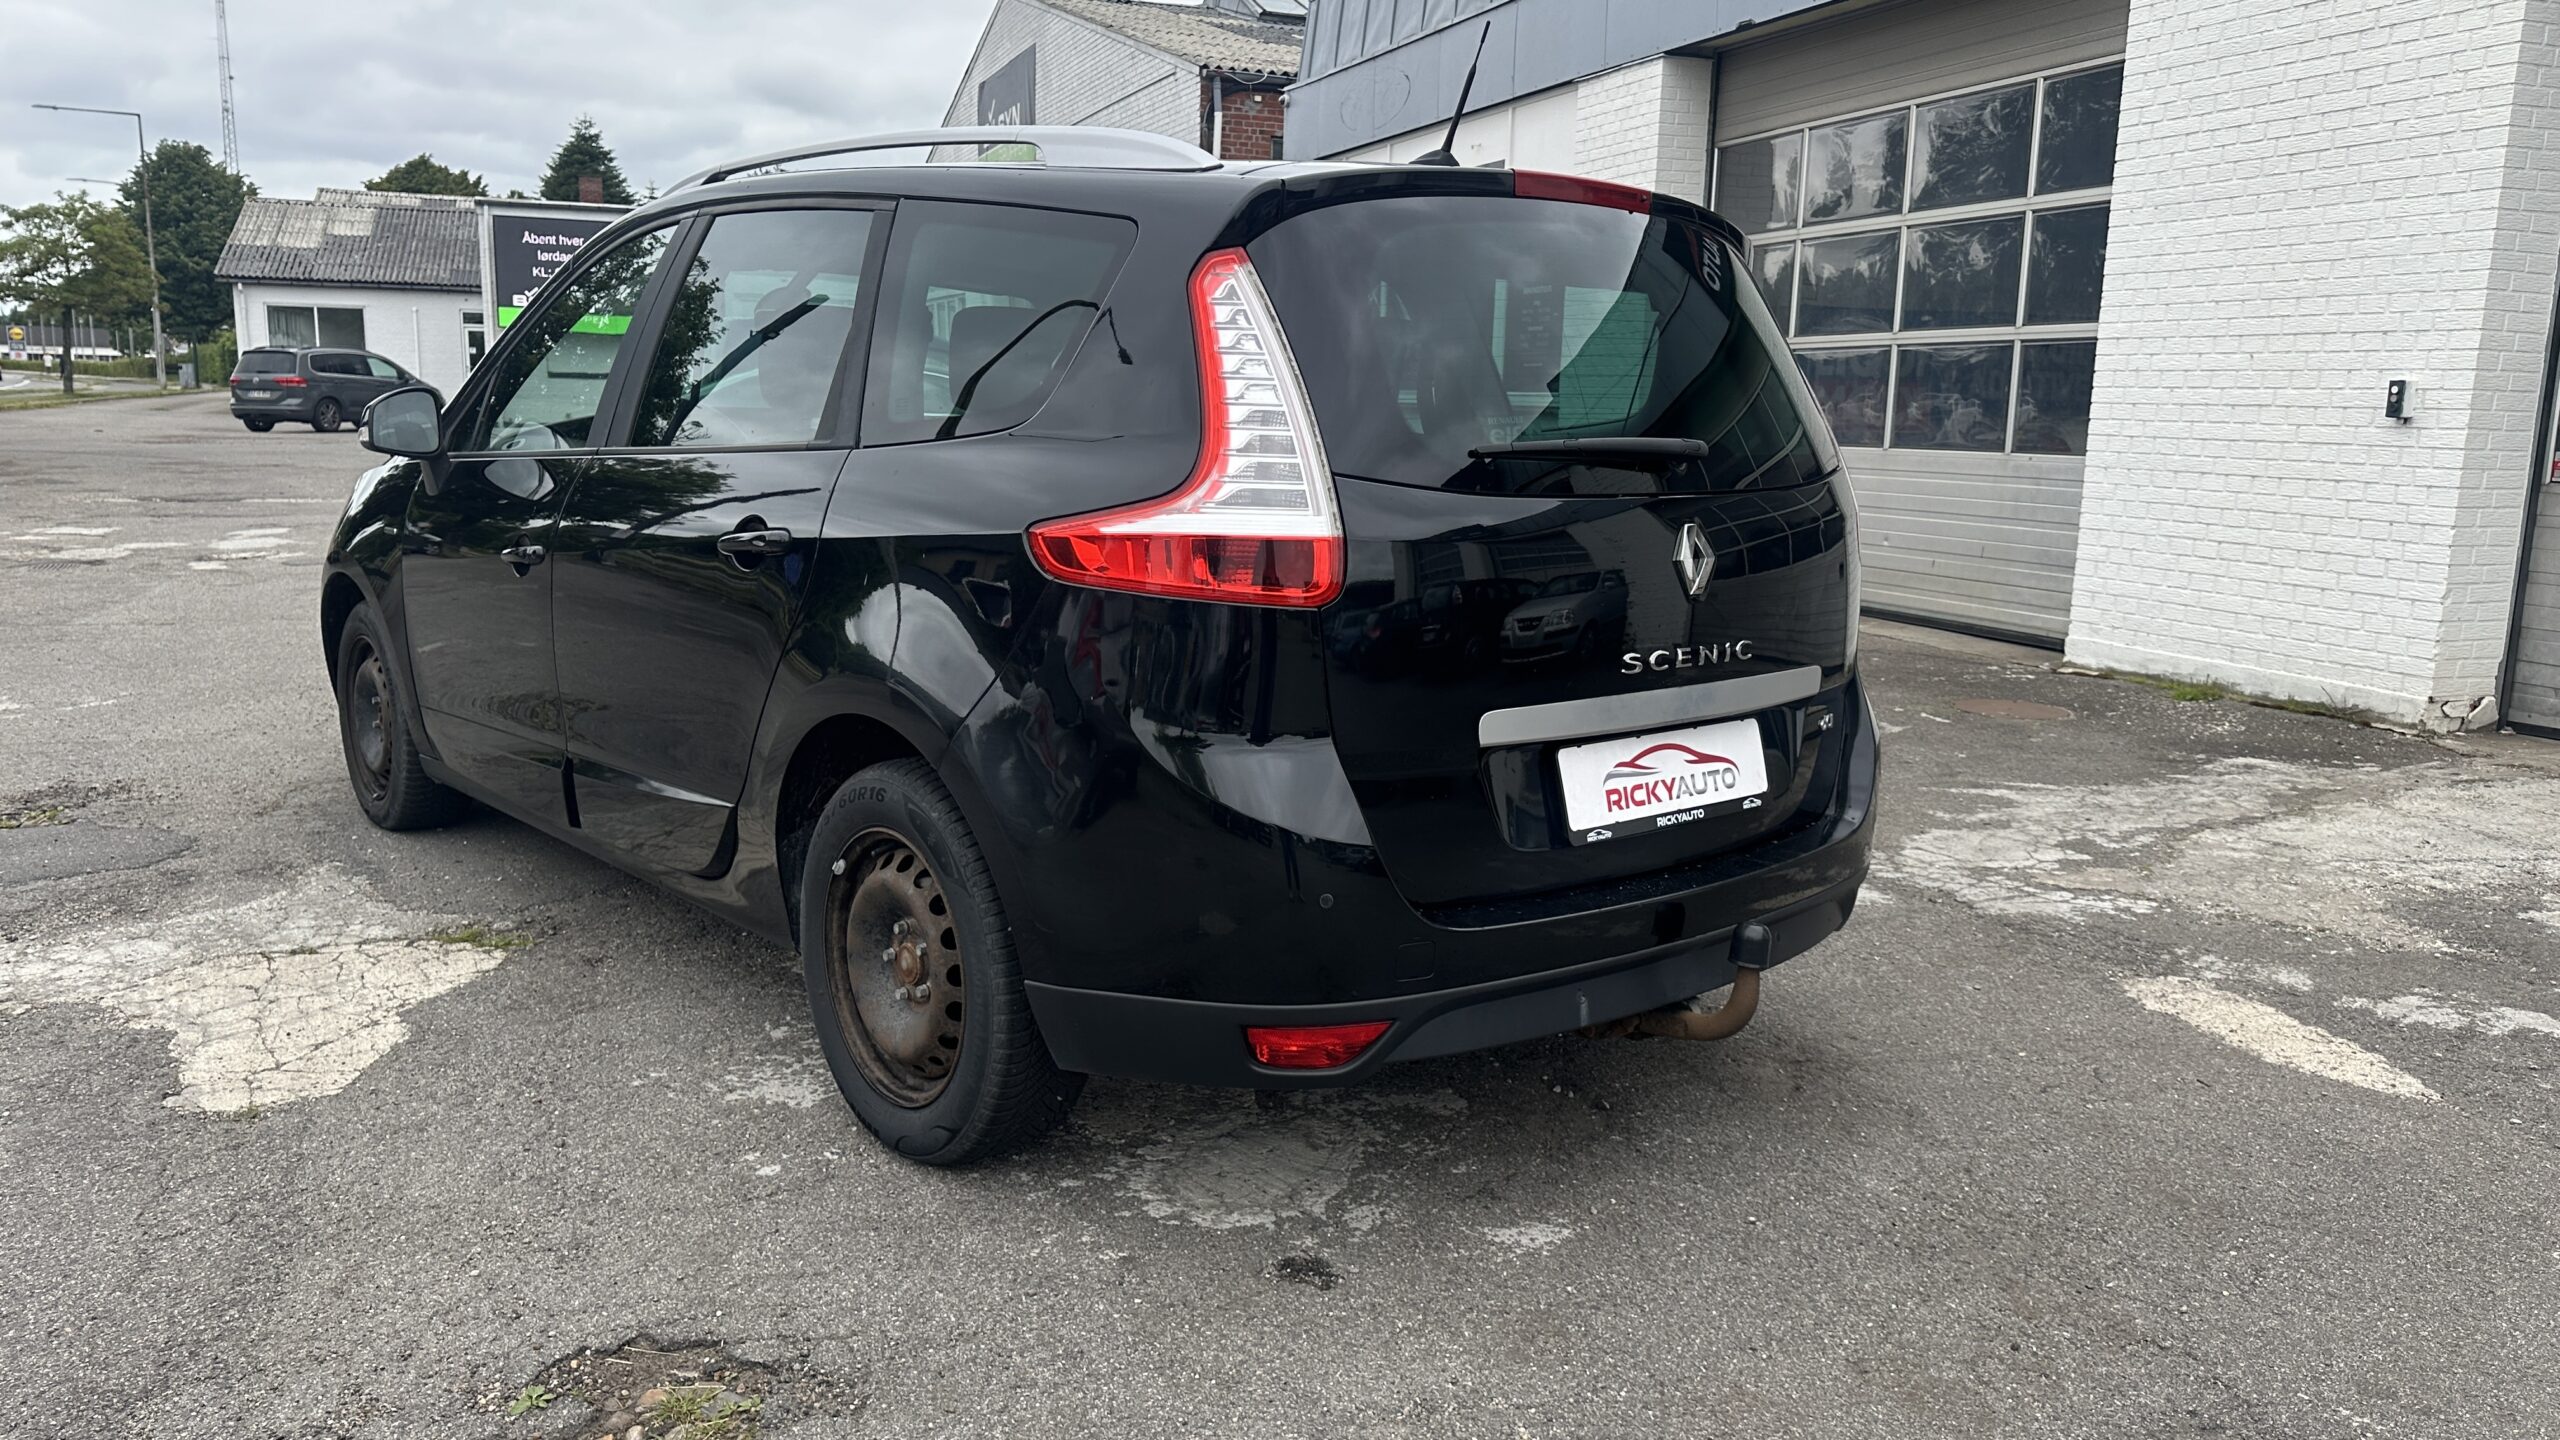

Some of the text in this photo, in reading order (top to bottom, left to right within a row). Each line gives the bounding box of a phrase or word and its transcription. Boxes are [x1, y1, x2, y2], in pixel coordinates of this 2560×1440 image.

[522, 230, 584, 247] Åbent hver
[1621, 640, 1753, 675] SCENIC
[1605, 767, 1737, 813] RICKYAUTO
[1656, 808, 1705, 828] RICKYAUTO
